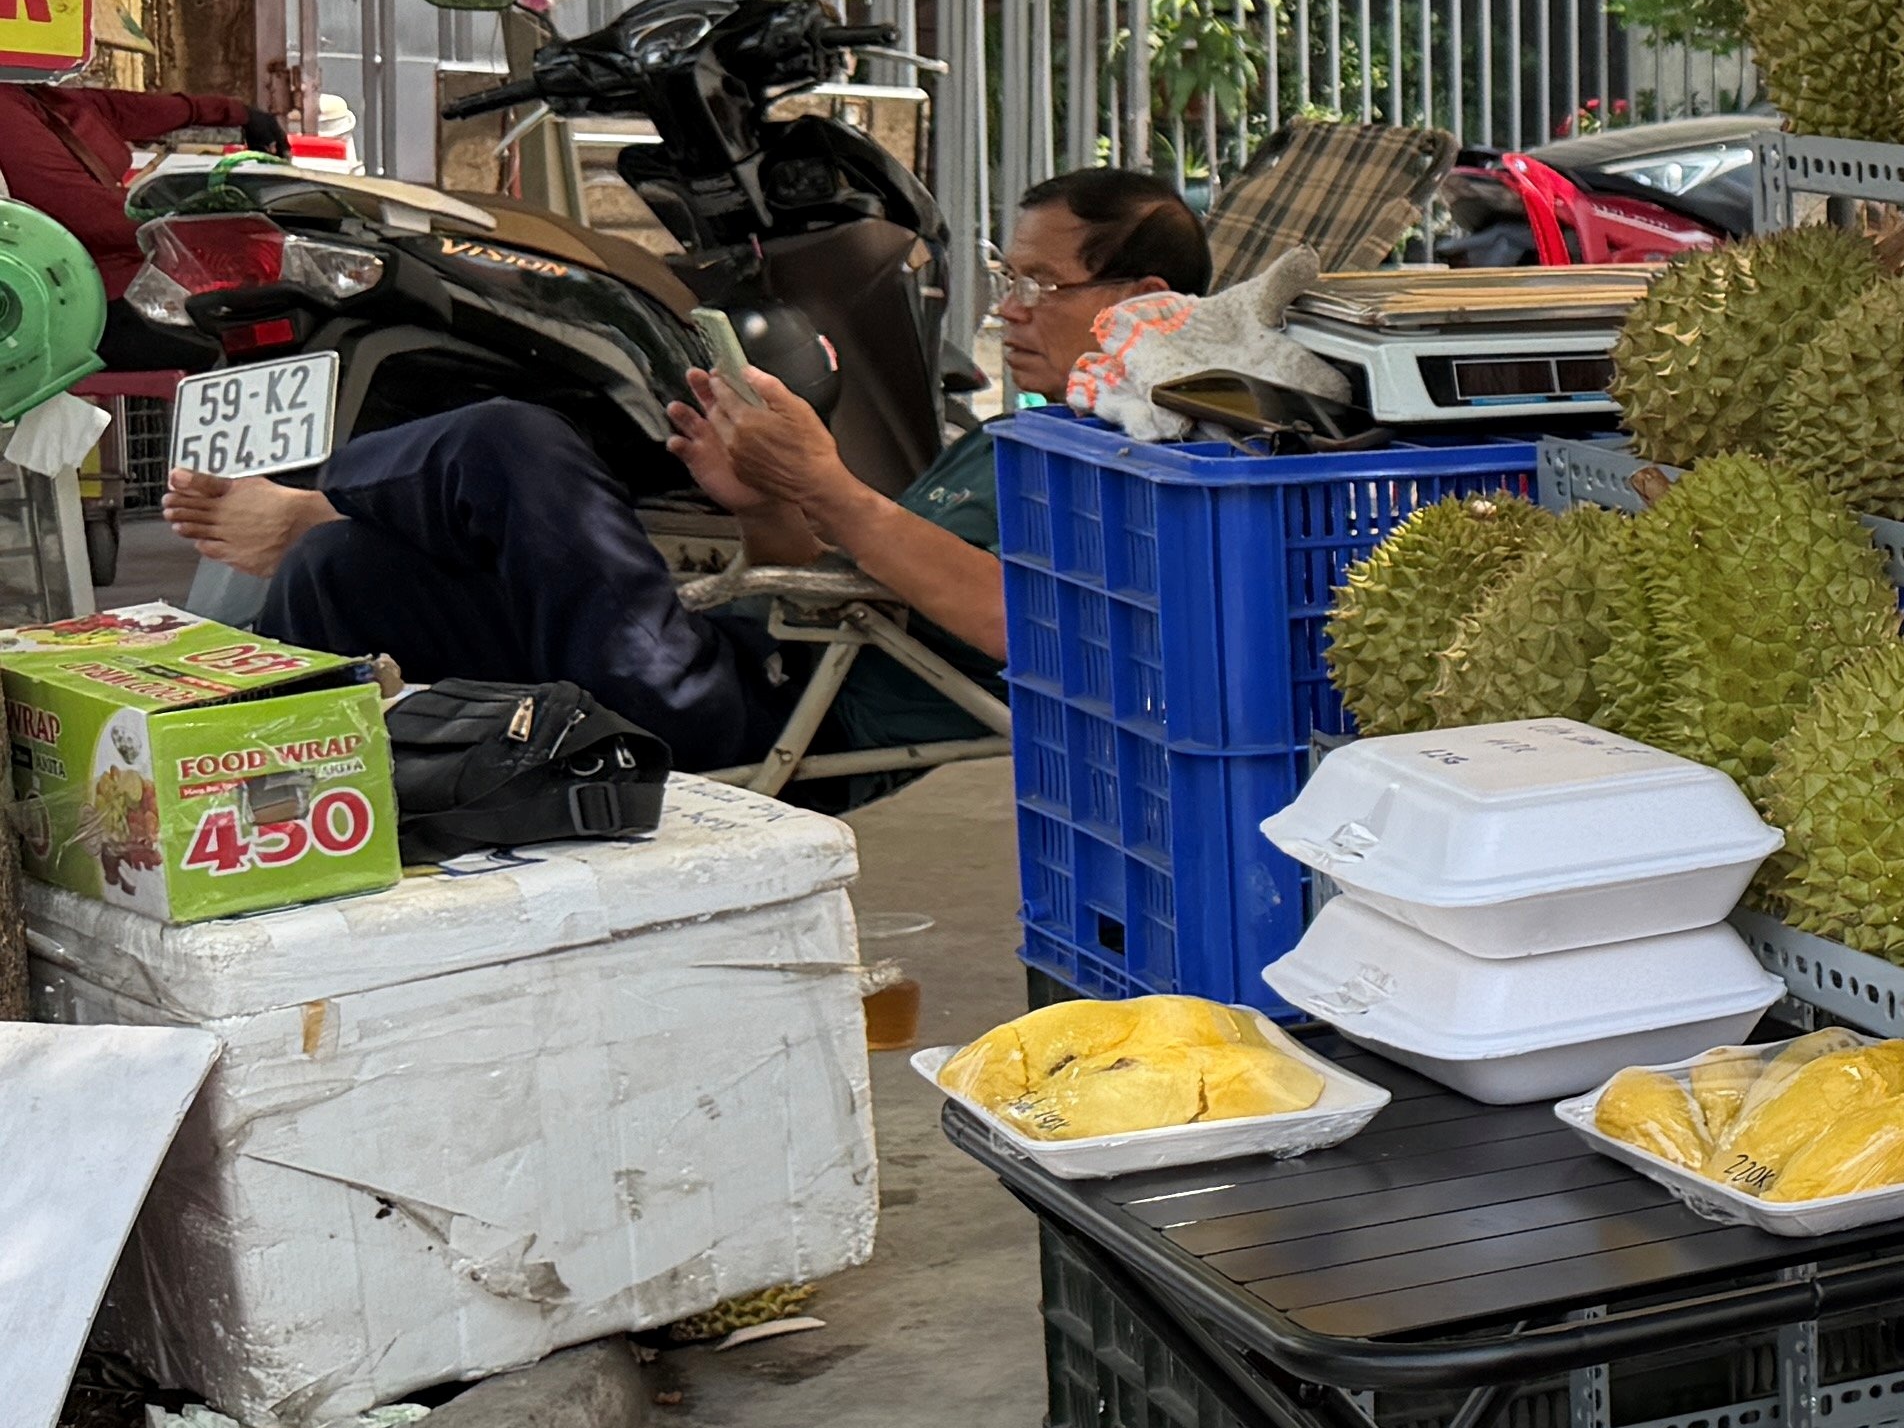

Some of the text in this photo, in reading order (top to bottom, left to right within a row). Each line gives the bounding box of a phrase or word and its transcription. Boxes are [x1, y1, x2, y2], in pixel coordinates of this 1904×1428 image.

[199, 365, 311, 427] 59-K2
[181, 413, 316, 474] 564.51
[178, 734, 363, 780] FOOD WRAP
[182, 788, 374, 876] 450
